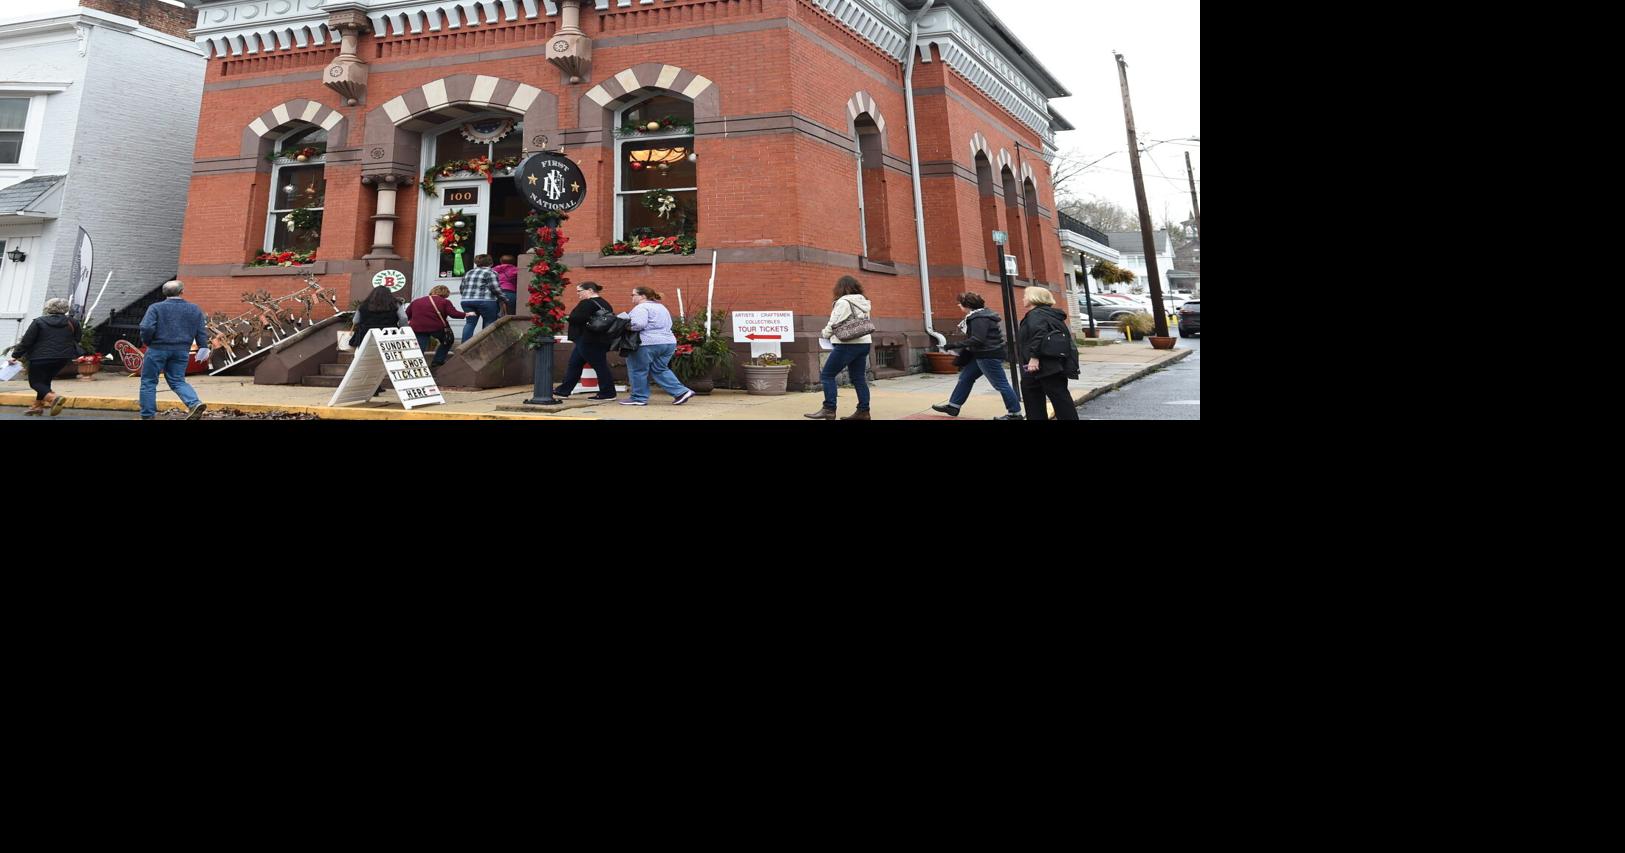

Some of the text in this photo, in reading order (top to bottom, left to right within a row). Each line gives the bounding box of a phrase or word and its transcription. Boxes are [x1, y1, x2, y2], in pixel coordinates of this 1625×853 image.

[541, 160, 570, 172] FIRST
[450, 192, 472, 201] 100
[530, 192, 577, 210] NATIONAL
[384, 276, 395, 287] B
[380, 340, 411, 351] SUNDAY
[384, 351, 404, 360] GIFT
[403, 359, 424, 369] SHOP
[391, 368, 430, 380] TICKETS
[406, 387, 428, 398] HERE
